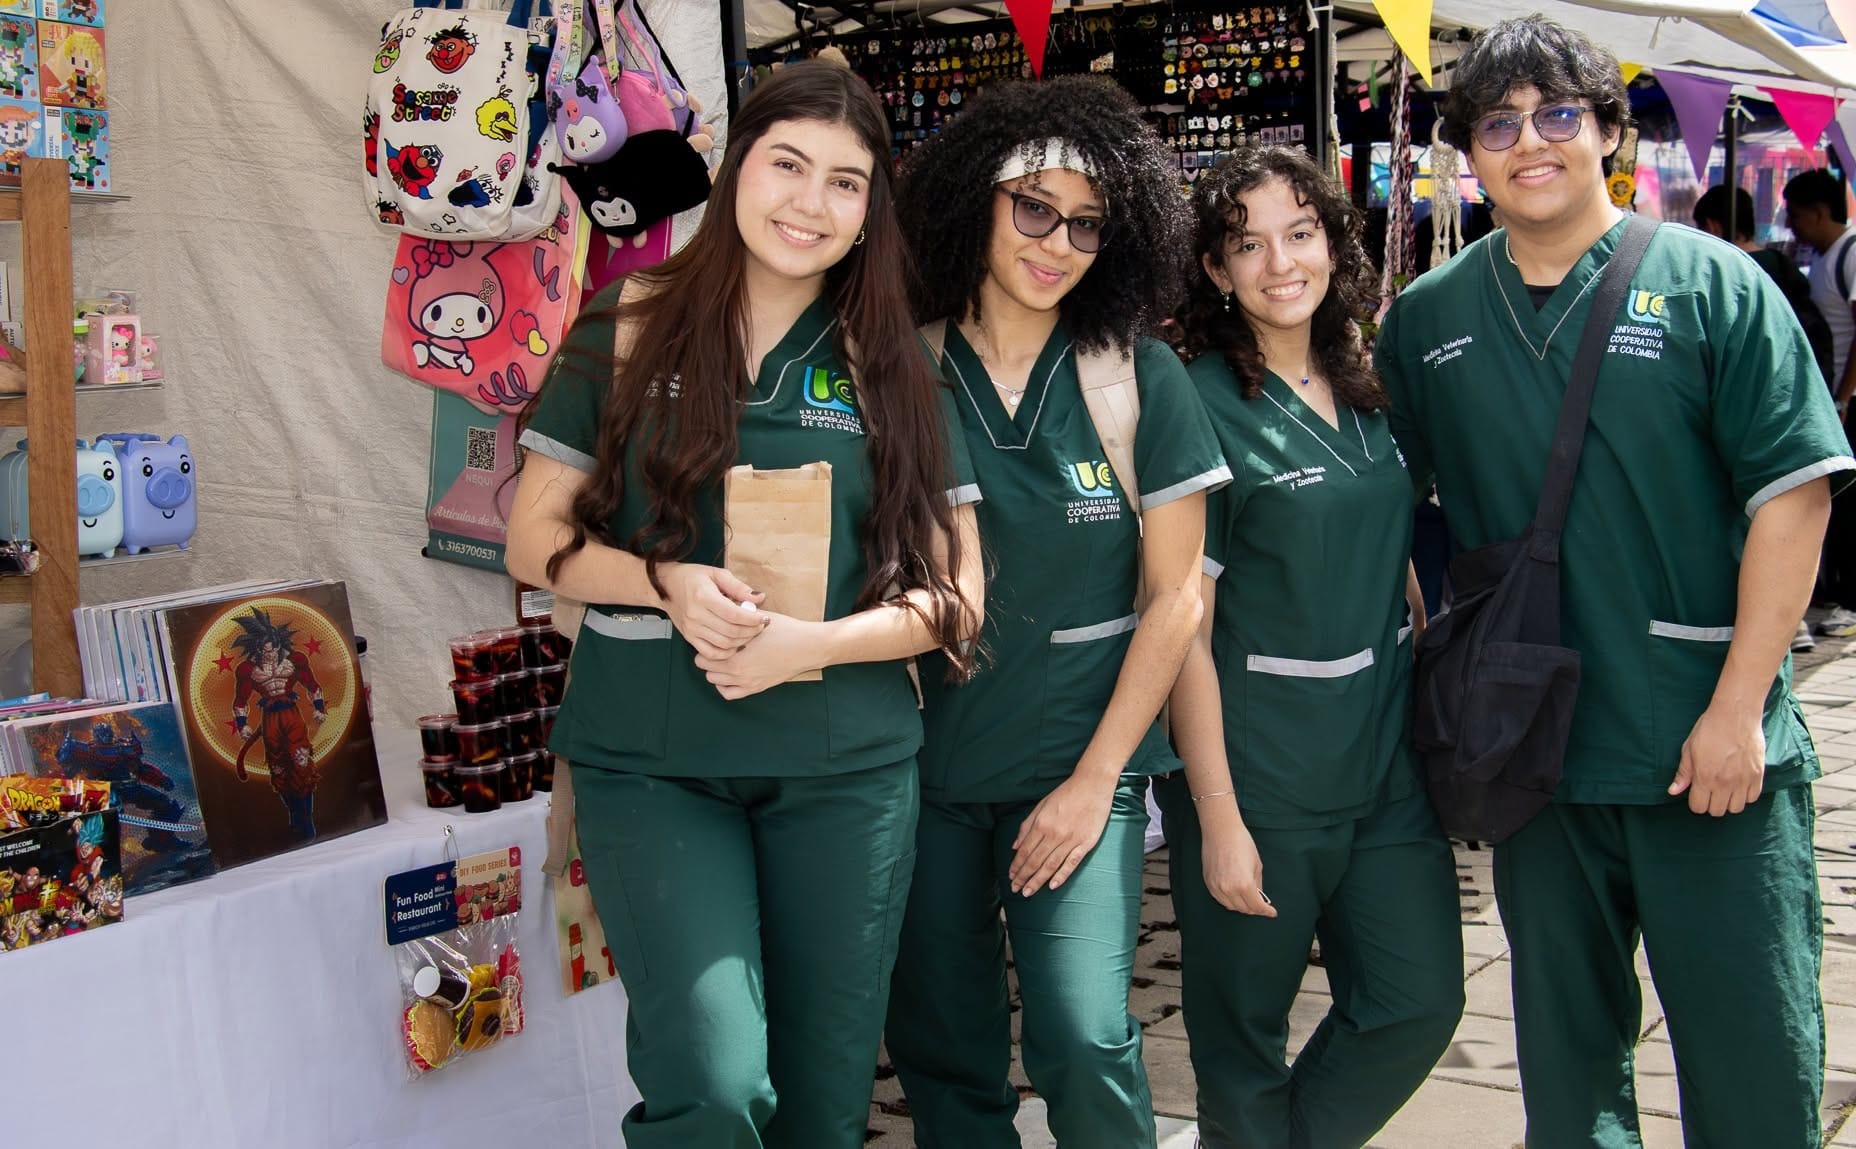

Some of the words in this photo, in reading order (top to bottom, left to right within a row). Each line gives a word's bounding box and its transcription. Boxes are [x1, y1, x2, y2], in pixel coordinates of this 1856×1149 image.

[392, 83, 458, 106] Sesame
[391, 103, 452, 122] Street
[1615, 325, 1663, 337] UNIVERSIDAD
[1609, 335, 1663, 349] COOPERATIVA
[1620, 345, 1660, 360] COLOMBIA
[799, 409, 861, 424] UNIVERSIDAD
[800, 414, 861, 430] COOPERATIVA
[466, 472, 493, 487] NEQUI
[1067, 497, 1120, 508] UNIVERSIDAD
[1067, 504, 1120, 517] COOPERATIVA
[1084, 513, 1120, 522] COLOMBIA
[477, 514, 490, 527] de
[446, 541, 496, 560] 3163700531
[7, 787, 60, 811] DRAGON
[7, 840, 33, 850] WELCOME
[460, 868, 469, 877] DIY
[472, 864, 487, 874] FOOD
[488, 859, 507, 870] SERIES
[396, 896, 412, 907] Fun
[414, 889, 433, 902] Food
[397, 901, 442, 921] Restaurant
